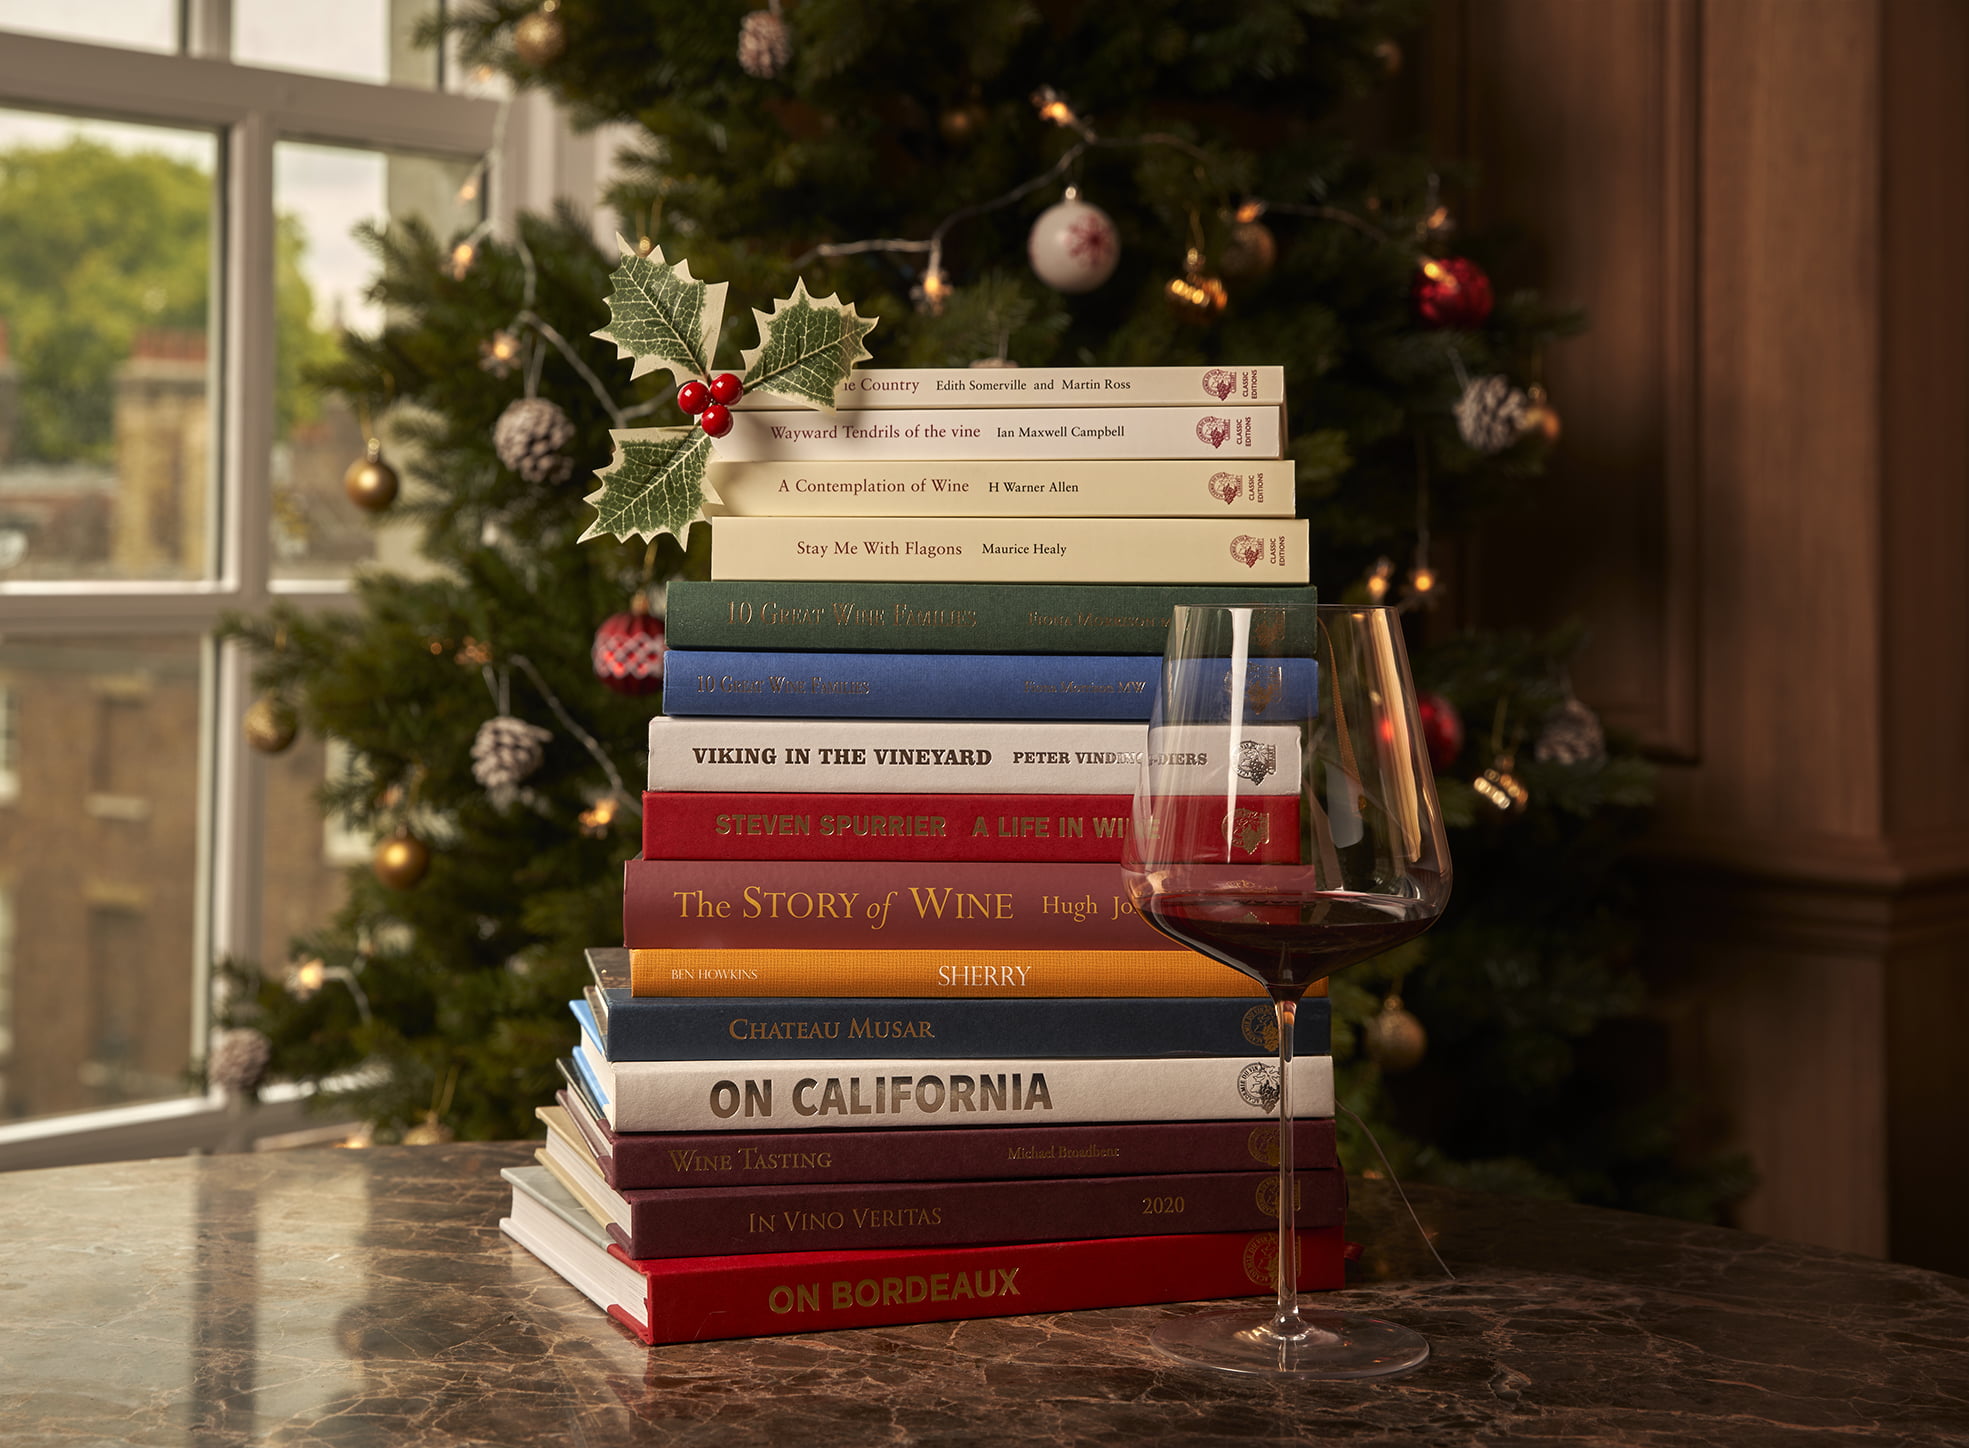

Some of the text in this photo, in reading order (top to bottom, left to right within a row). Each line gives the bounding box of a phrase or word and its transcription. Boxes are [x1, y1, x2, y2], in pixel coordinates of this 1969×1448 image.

[861, 377, 920, 394] Country
[936, 379, 966, 391] Edith
[969, 379, 1027, 391] Somerville
[1033, 379, 1054, 390] and
[1061, 378, 1101, 390] Martin
[1104, 378, 1131, 390] Ross
[770, 424, 1125, 442] Wayward Tendrils of the vine Ian Maxwell Campbell
[778, 478, 1079, 496] A Contemplation of Wine H Warner Allen
[797, 540, 1067, 559] Stay Me With Flagons Maurice Healy
[727, 601, 752, 625] 10
[697, 674, 716, 693] 10
[1118, 681, 1147, 693] MW
[693, 748, 777, 765] VIKING
[785, 748, 811, 764] IN
[818, 748, 866, 765] THE
[873, 749, 993, 766] VINEYARD
[1012, 751, 1070, 765] PETER
[715, 814, 810, 836] STEVEN
[819, 815, 946, 837] SPURRIER
[971, 816, 989, 837] A
[998, 816, 1049, 838] LIFE
[1059, 816, 1083, 838] IN
[673, 890, 731, 919] The
[742, 885, 859, 919] STORY
[866, 890, 898, 930] of
[908, 886, 1015, 920] WINE
[1042, 895, 1099, 922] Hugh
[671, 969, 758, 980] BEN HOWKINS
[938, 965, 1031, 987] SHERRY
[728, 1017, 936, 1040] CHATEAU MUSAR
[709, 1072, 1054, 1119] ON CALIFORNIA
[668, 1147, 833, 1172] WINE TASTING
[1007, 1144, 1120, 1160] Michael Broadbent
[1142, 1196, 1185, 1214] 2020
[749, 1207, 943, 1233] IN VINO VERITAS
[768, 1267, 1021, 1314] ON BORDEAUX
